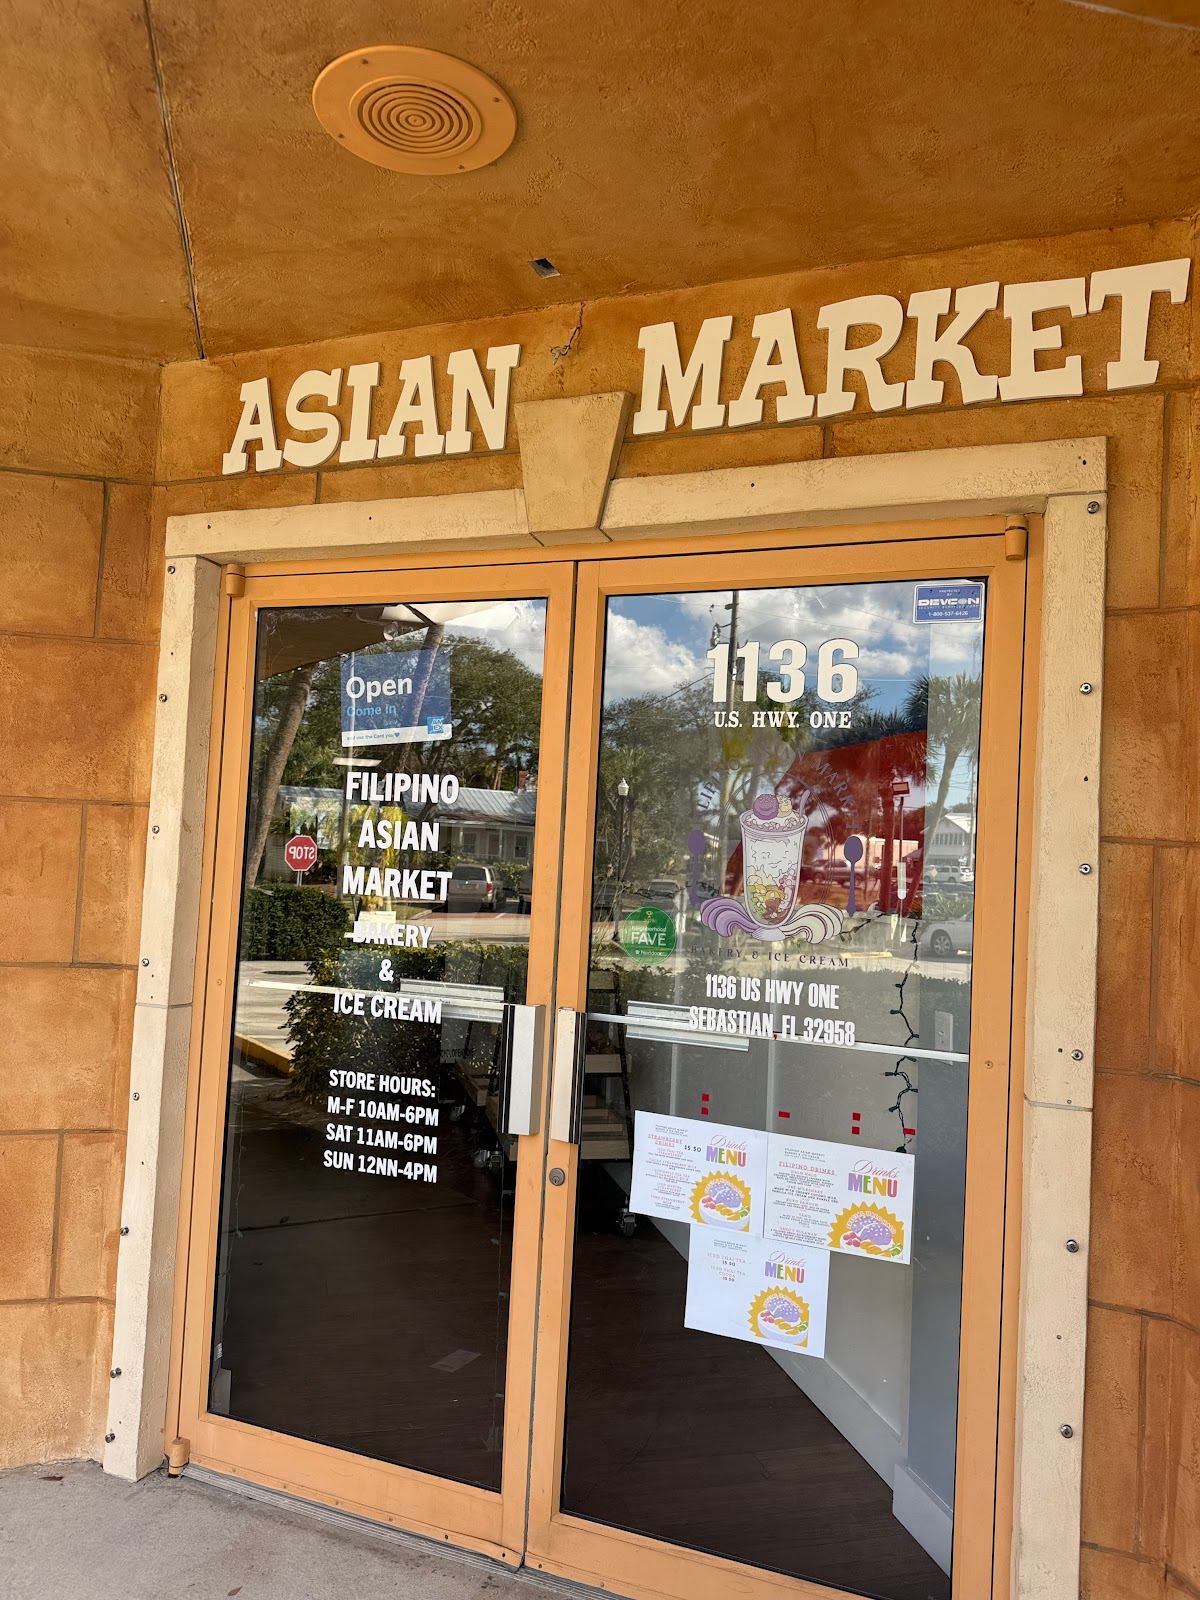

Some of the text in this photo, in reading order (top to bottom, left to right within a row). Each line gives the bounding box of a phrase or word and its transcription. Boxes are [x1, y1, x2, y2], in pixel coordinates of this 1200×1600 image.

[222, 257, 1191, 476] ASIAN MARKET
[918, 597, 980, 606] DEVCON
[706, 638, 859, 703] 1136
[345, 676, 413, 703] Open
[346, 703, 397, 717] Come In
[713, 711, 852, 729] U.S. HWY. ONE
[346, 771, 459, 804] FILIPINO
[358, 819, 440, 851] ASIAN
[342, 865, 452, 900] MARKET
[352, 920, 433, 948] BAKERY
[631, 931, 667, 946] FAVE
[379, 958, 394, 982] &
[768, 952, 790, 962] ICE
[799, 955, 849, 967] CREAM
[705, 973, 840, 1010] 1136 US HWY ONE
[333, 990, 442, 1024] ICE CREAM
[782, 1014, 799, 1040] FL
[803, 1017, 855, 1046] 32958
[329, 1069, 436, 1098] STORE HOURS:
[327, 1096, 439, 1126] M-F 10AM-6PM
[326, 1123, 437, 1155] SAT 11AM-6PM
[323, 1150, 438, 1183] SUN 12NN-4PM
[706, 1145, 746, 1167] MENU
[853, 1159, 901, 1178] Drinks
[847, 1172, 898, 1198] MENU
[764, 1261, 805, 1284] MENU
